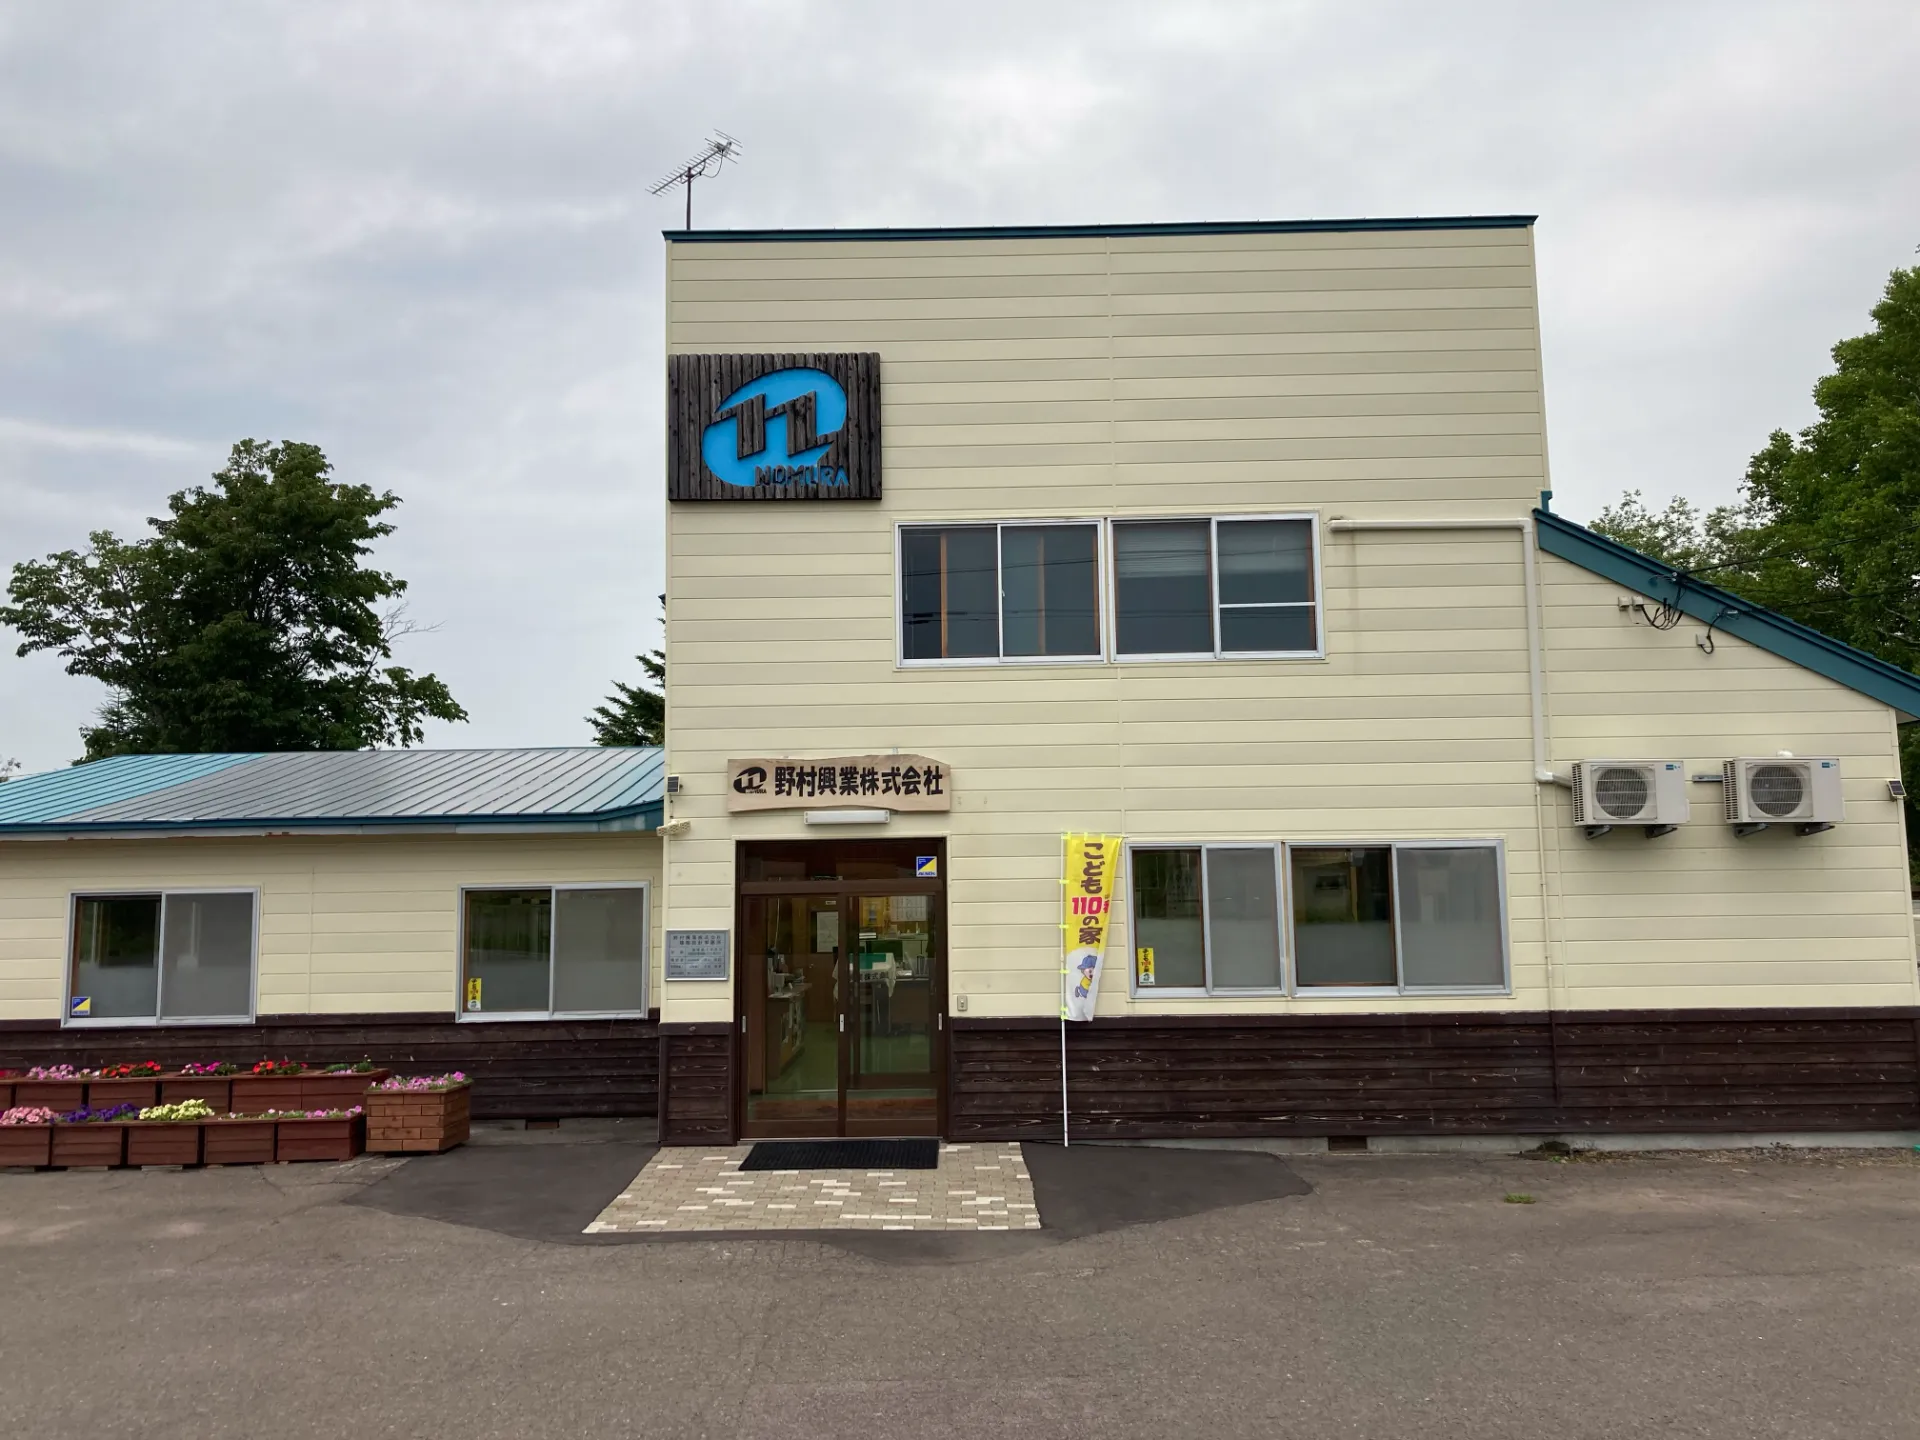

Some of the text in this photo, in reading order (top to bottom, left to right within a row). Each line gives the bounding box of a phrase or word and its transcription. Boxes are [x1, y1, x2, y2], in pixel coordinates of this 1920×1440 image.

[774, 765, 943, 797] 野村興業株式会社
